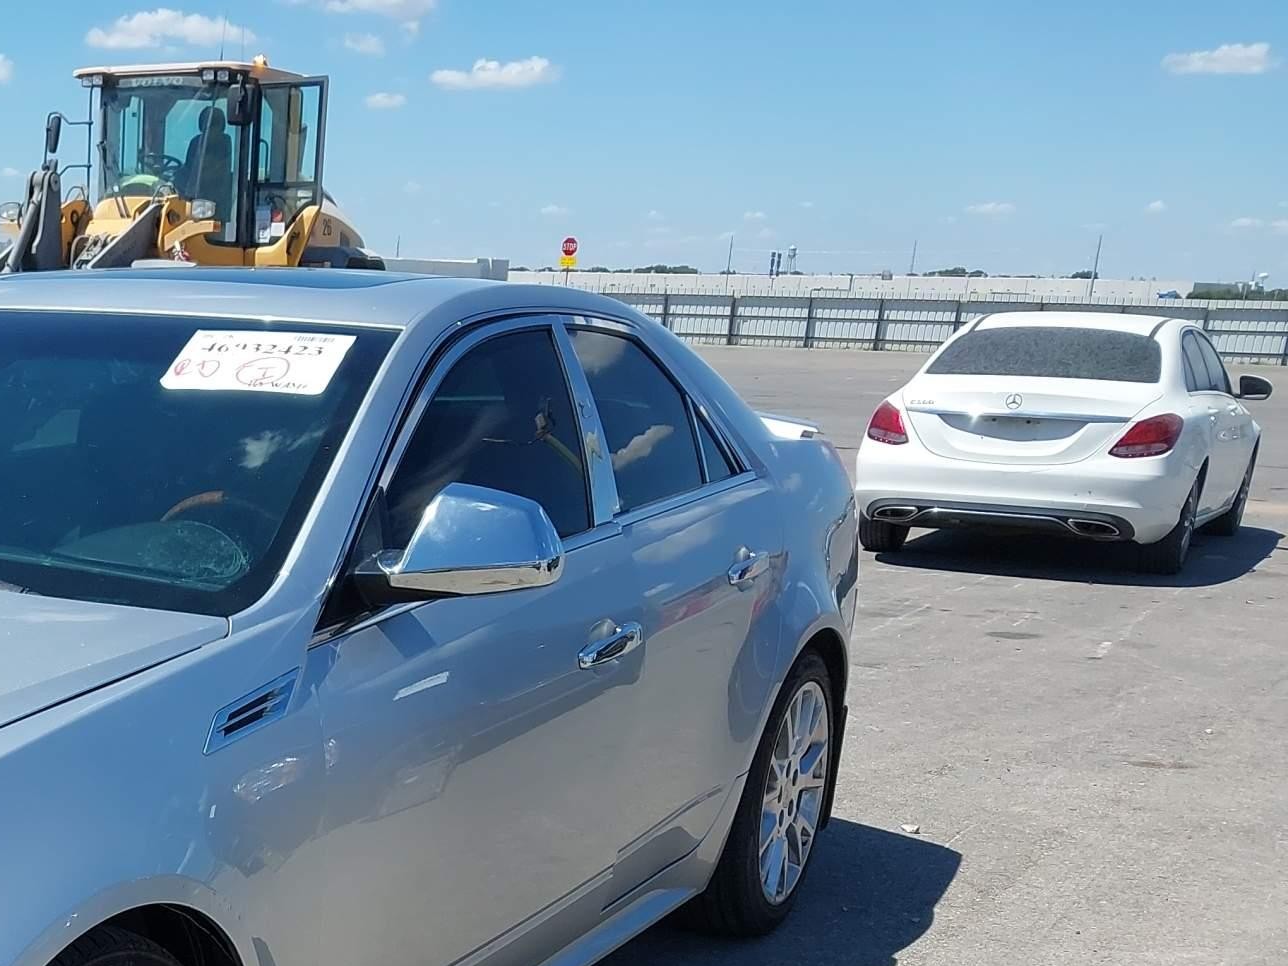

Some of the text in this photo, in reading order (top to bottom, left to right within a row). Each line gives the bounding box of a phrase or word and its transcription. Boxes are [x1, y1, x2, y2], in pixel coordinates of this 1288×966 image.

[130, 76, 183, 88] VOLVO
[322, 218, 332, 236] 26
[563, 242, 577, 251] STOP
